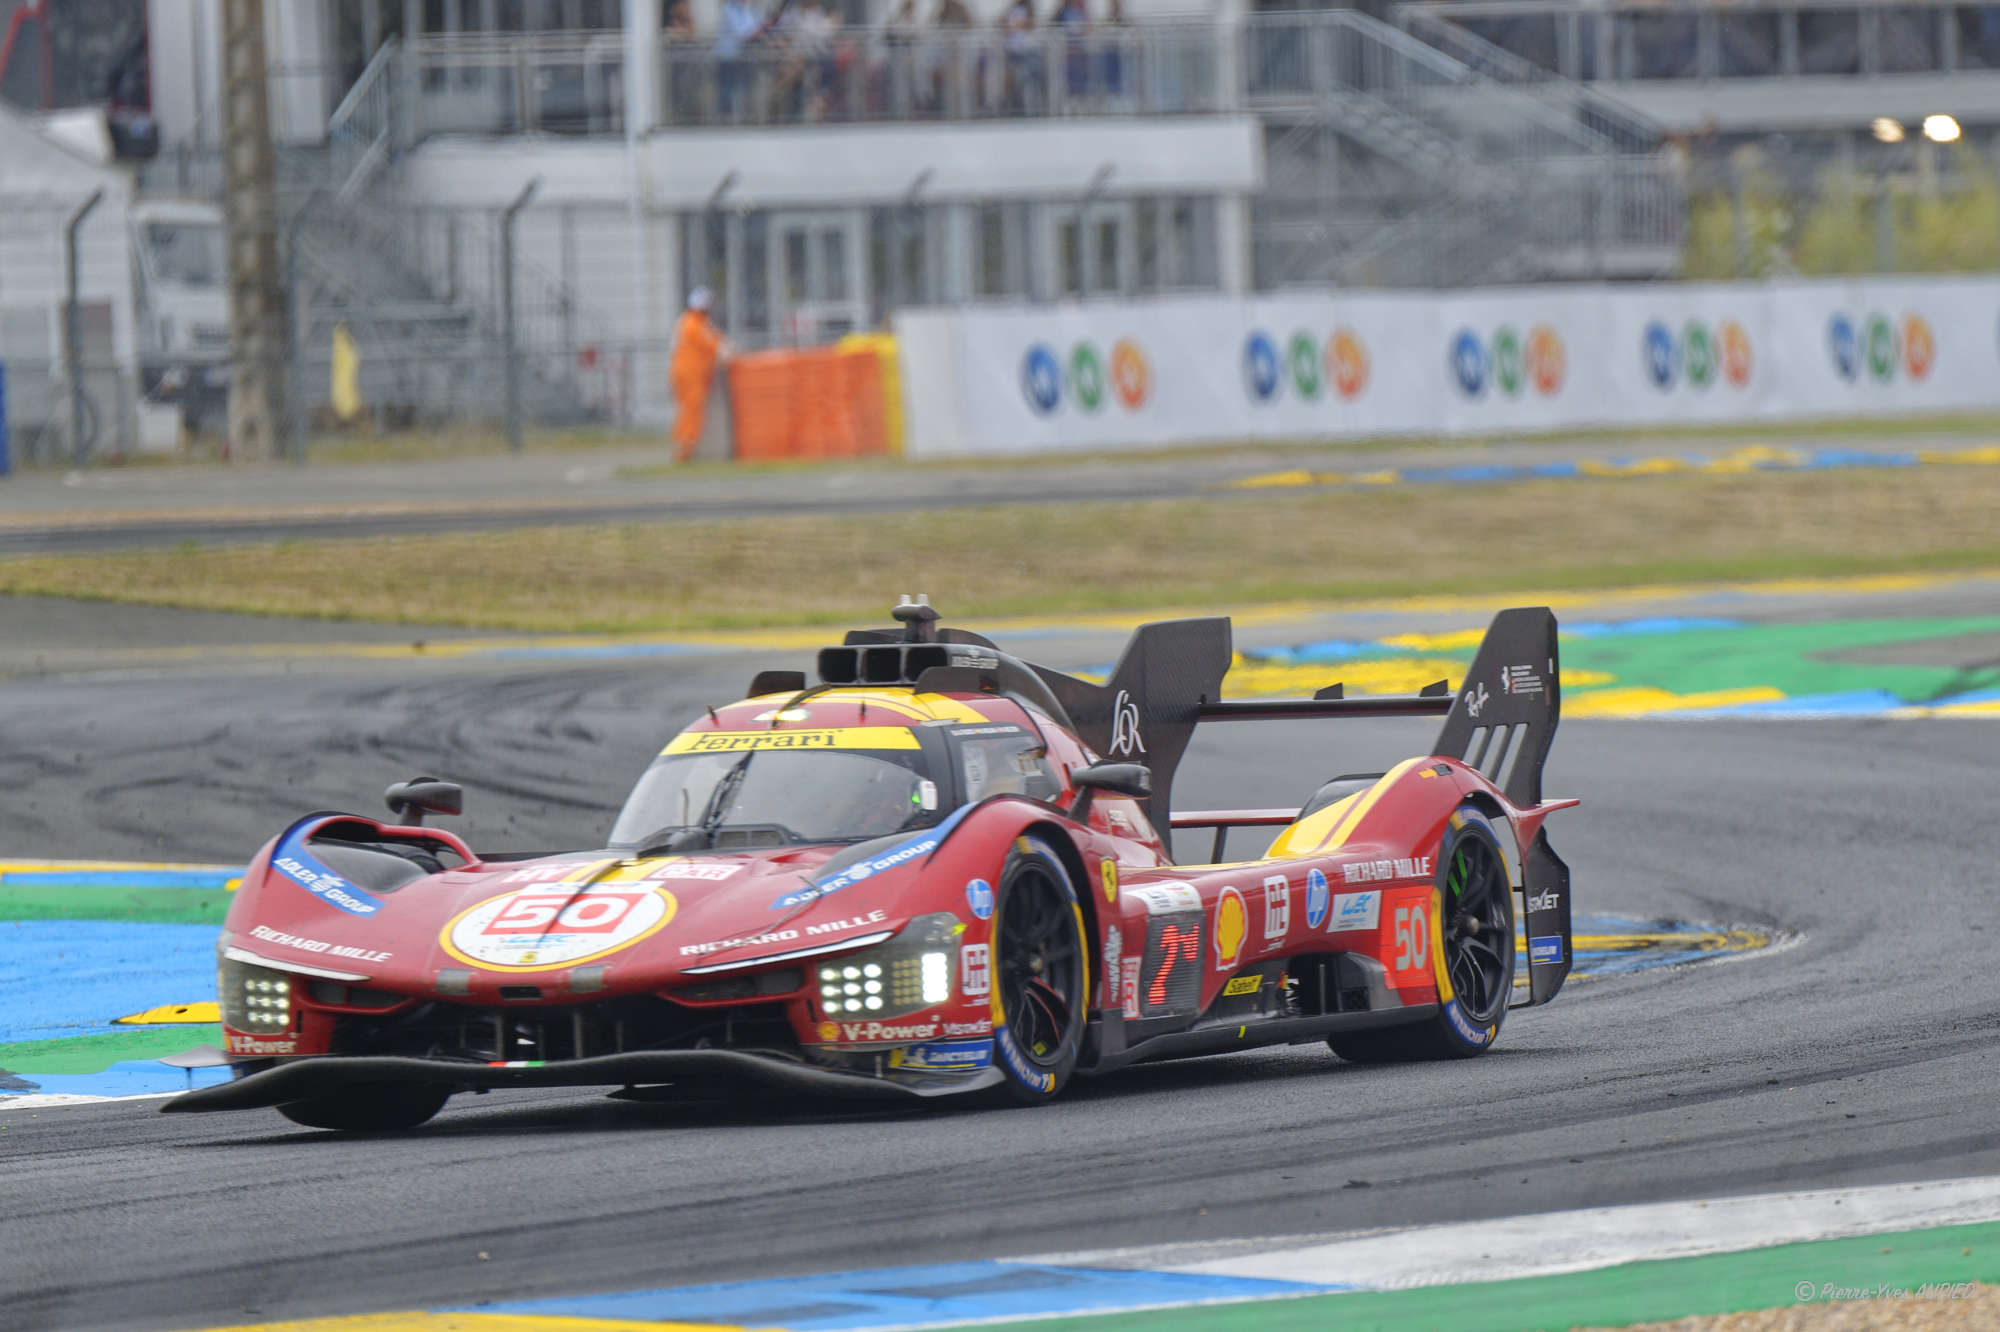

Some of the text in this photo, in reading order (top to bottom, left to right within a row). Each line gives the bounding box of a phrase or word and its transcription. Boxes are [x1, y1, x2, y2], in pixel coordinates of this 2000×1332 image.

[687, 731, 842, 751] Ferrari
[274, 857, 376, 913] ADLER GROUP
[783, 839, 938, 906] ADLER GROUP
[1342, 857, 1431, 883] RICHARD MILLE
[492, 897, 629, 928] 50
[249, 925, 393, 962] RICHARD MILLE
[679, 909, 888, 955] RICHARD MILLE
[1394, 905, 1427, 970] 50
[230, 1035, 297, 1054] V-Power
[842, 1022, 938, 1041] V-Power
